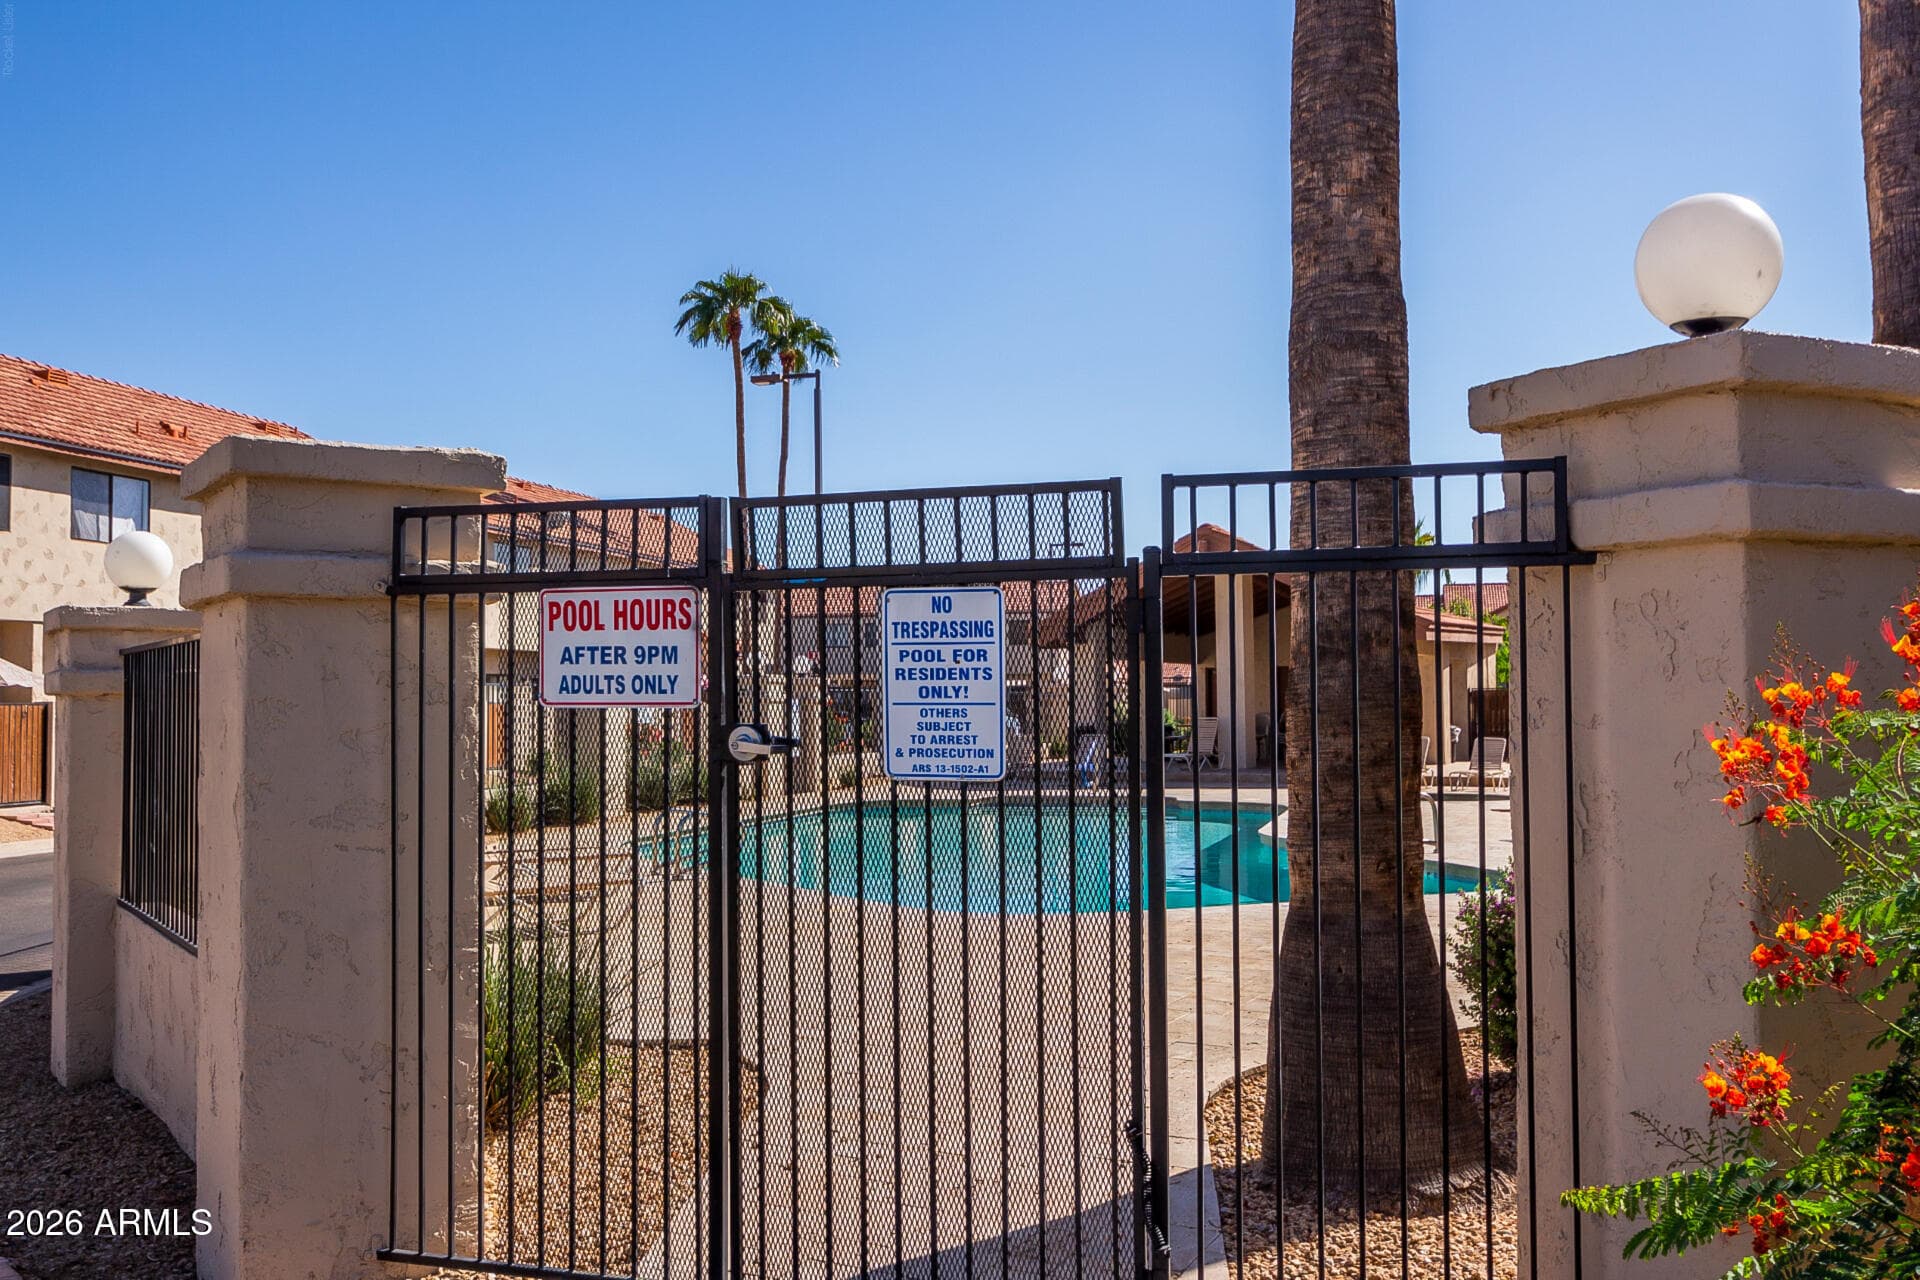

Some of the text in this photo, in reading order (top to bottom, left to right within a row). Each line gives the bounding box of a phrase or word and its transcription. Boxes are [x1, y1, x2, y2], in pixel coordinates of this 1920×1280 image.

[931, 596, 952, 613] NO
[548, 598, 691, 631] POOL HOURS
[892, 620, 994, 639] TRESPASSING
[560, 646, 678, 664] AFTER 9PM
[899, 649, 987, 662] POOL FOR
[895, 668, 992, 681] RESIDENTS
[559, 675, 678, 695] ADULTS ONLY
[918, 686, 968, 699] ONLY!
[920, 708, 968, 718] OTHERS
[917, 722, 971, 732] SUBJECT
[911, 735, 977, 745] TO ARREST
[896, 748, 994, 758] & PROSECUTION
[912, 764, 989, 773] ARS 13-1502-A1
